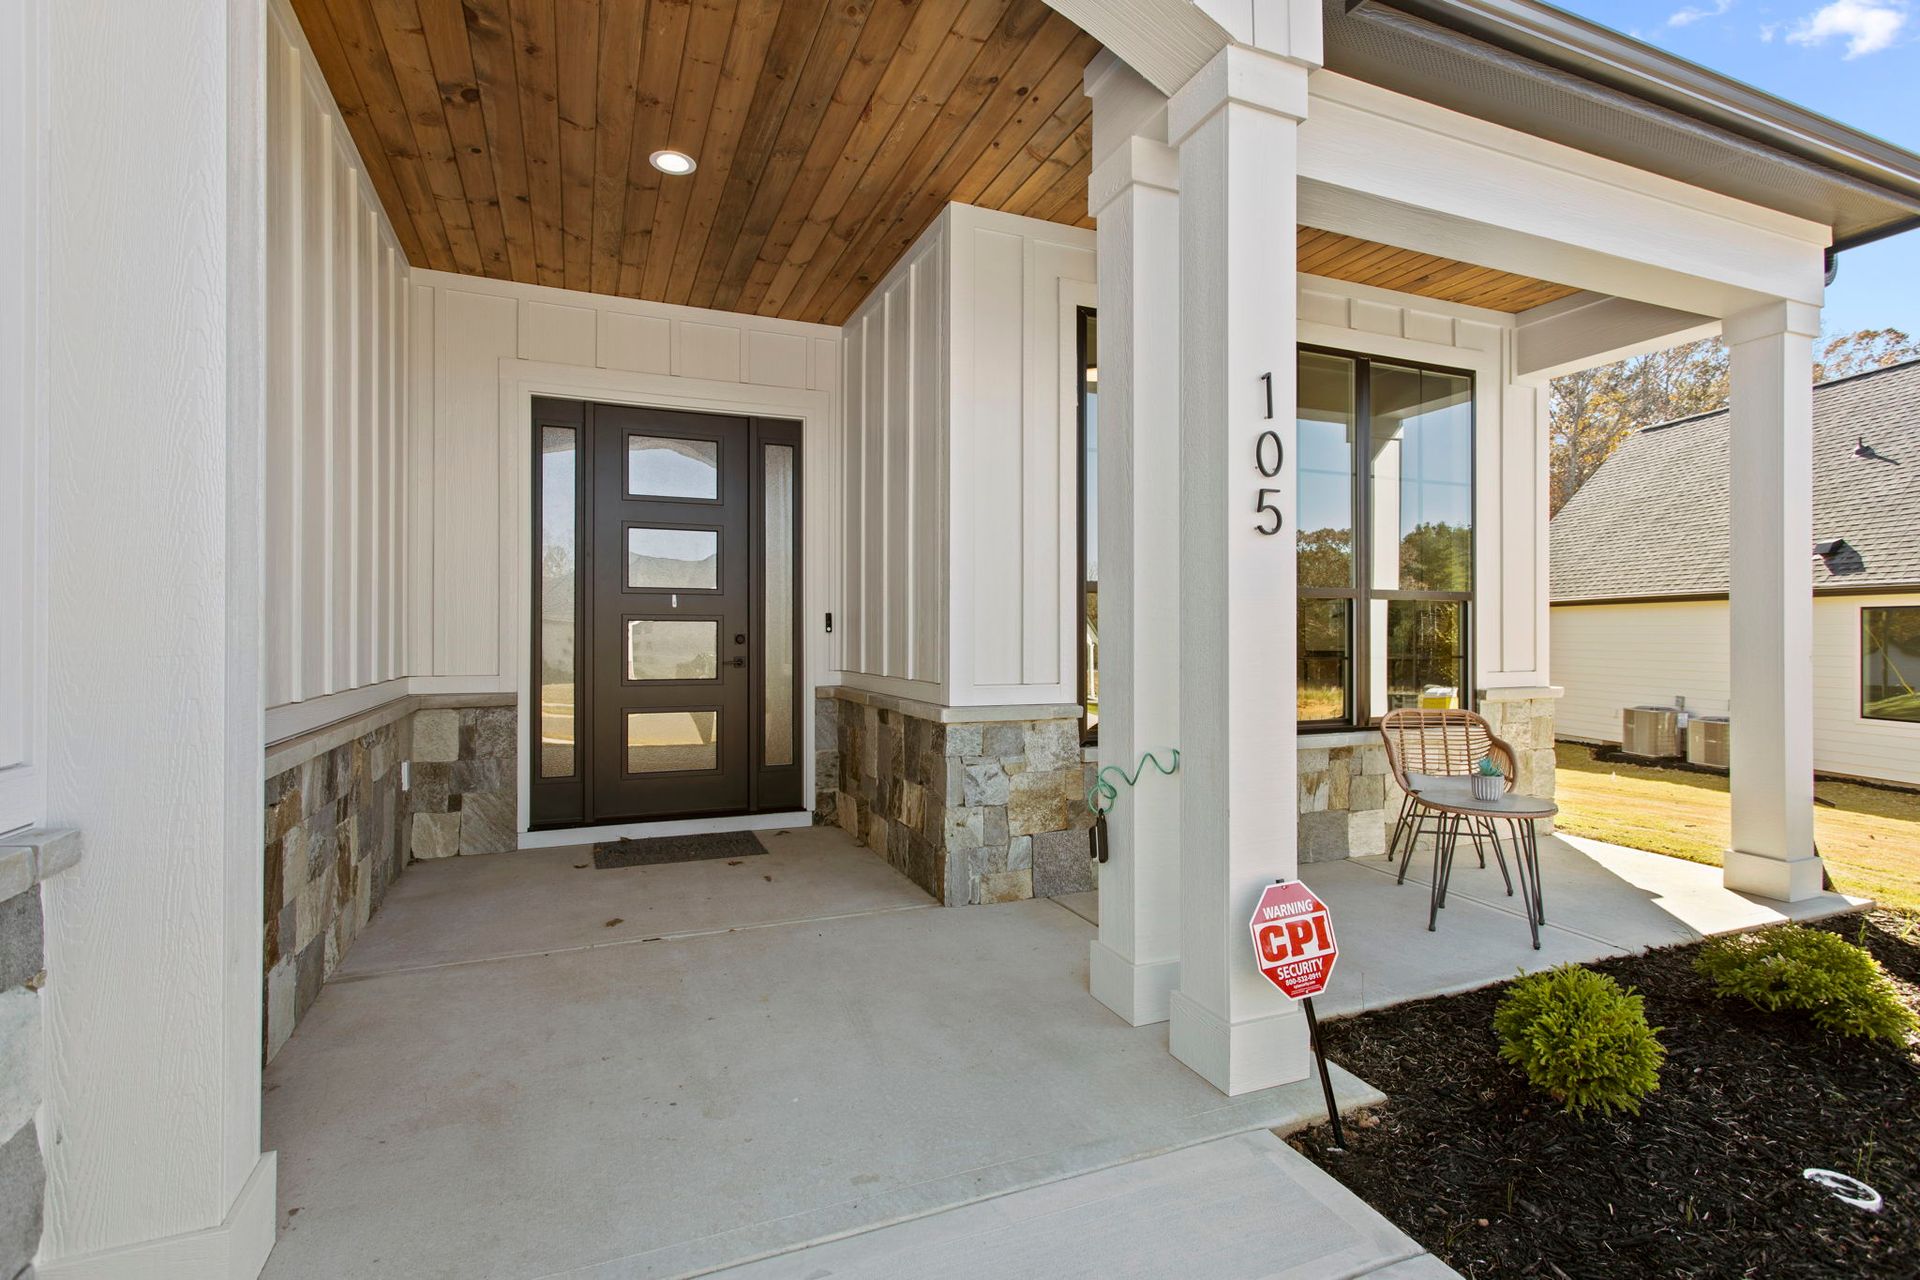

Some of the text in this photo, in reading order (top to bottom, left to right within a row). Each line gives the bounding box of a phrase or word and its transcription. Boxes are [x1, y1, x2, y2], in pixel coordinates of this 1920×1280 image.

[1256, 372, 1284, 536] 105
[1263, 899, 1313, 919] WARNING
[1259, 915, 1331, 962] CPI
[1277, 958, 1323, 980] SECURITY
